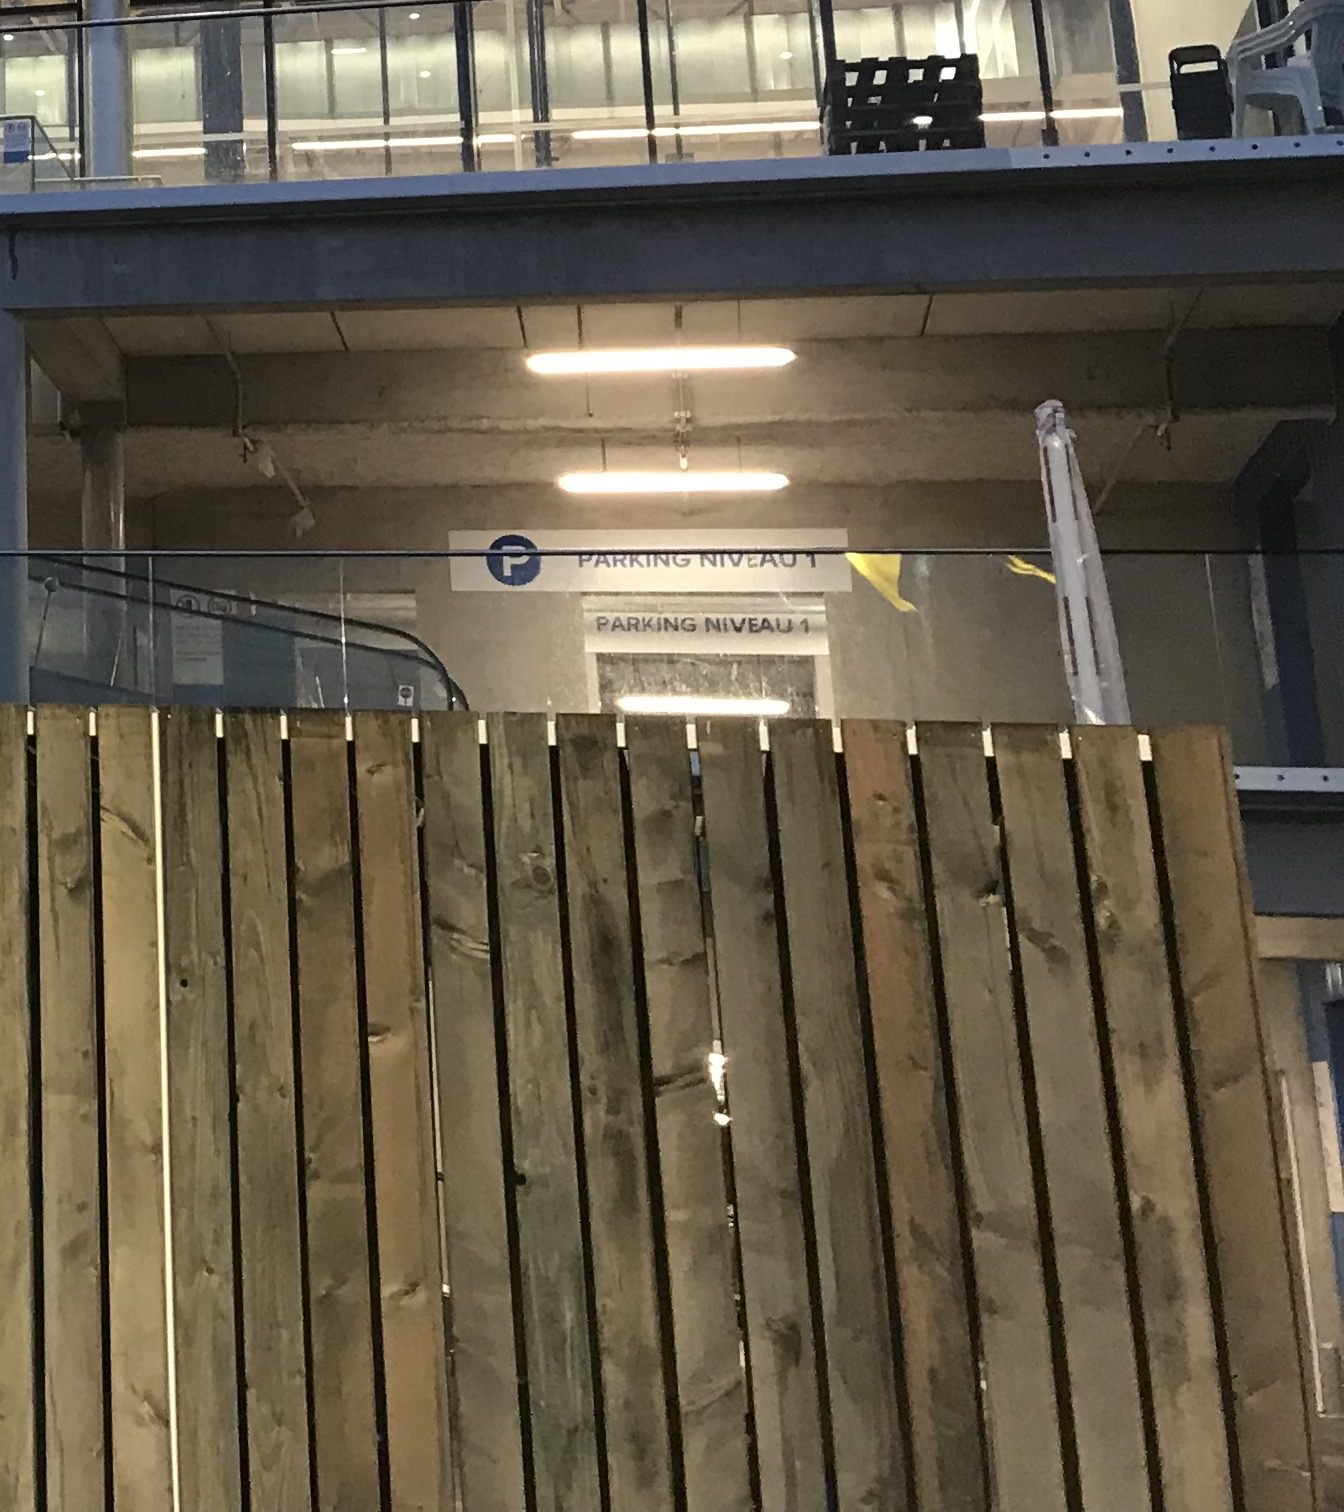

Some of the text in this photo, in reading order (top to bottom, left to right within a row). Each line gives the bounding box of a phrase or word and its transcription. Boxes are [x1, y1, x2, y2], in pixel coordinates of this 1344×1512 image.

[578, 553, 691, 568] PARKING
[699, 553, 797, 569] NIVEAU
[596, 616, 809, 634] PARKING NIVEAU 1
